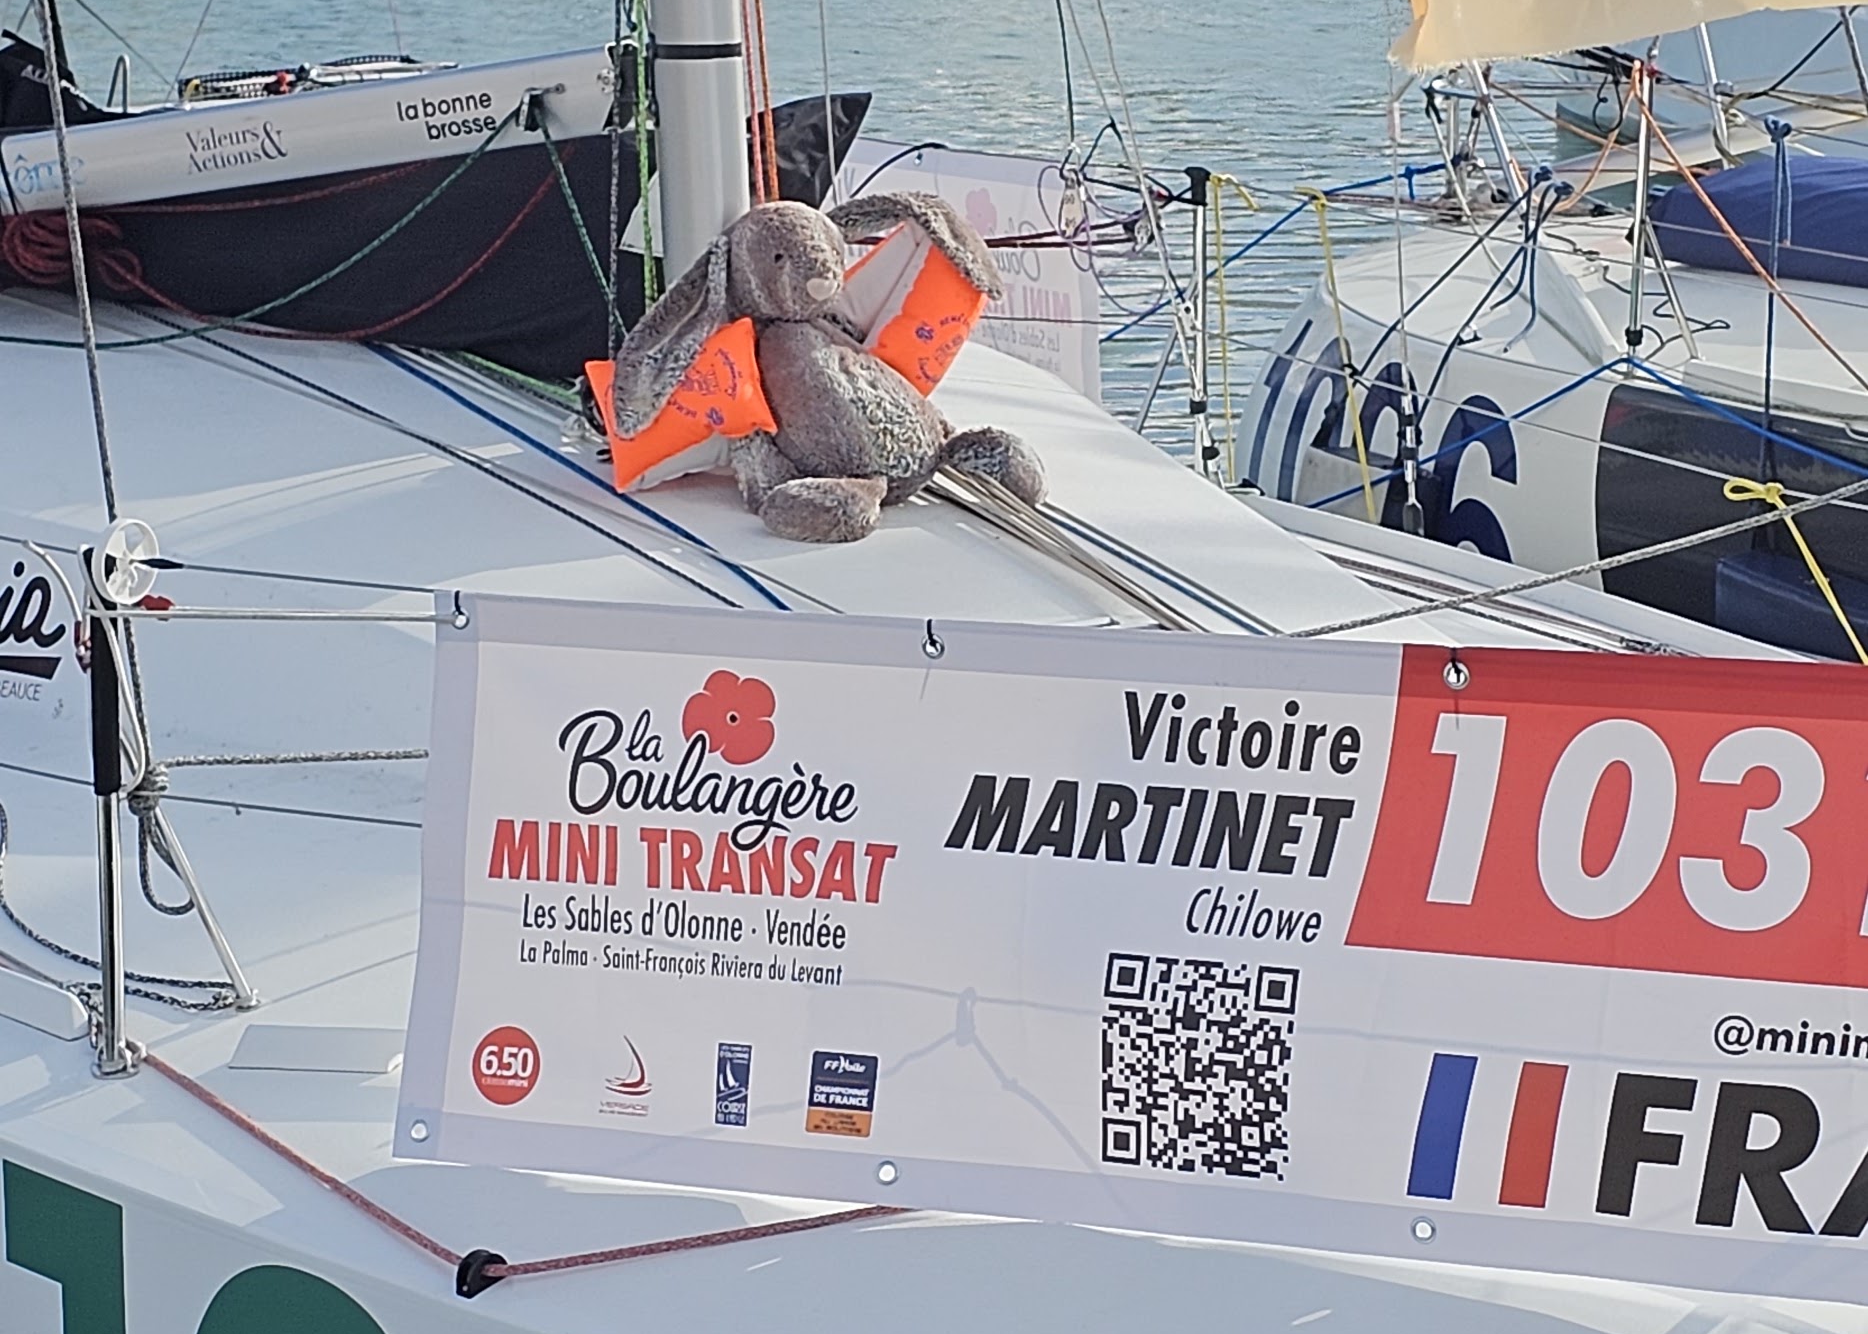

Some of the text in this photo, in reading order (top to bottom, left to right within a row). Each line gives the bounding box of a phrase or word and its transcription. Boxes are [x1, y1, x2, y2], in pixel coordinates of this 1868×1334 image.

[397, 93, 492, 121] la bonne
[425, 115, 497, 140] brosse
[186, 126, 260, 153] Valeurs
[188, 148, 262, 175] Actions
[625, 709, 663, 763] la
[1124, 690, 1361, 775] Victoire
[559, 710, 858, 851] Boulangère
[944, 774, 1355, 878] MARTINET
[1426, 712, 1868, 937] 103
[488, 819, 898, 904] MINI TRANSAT
[522, 893, 846, 949] Les Sables d'Olonne Vendée
[1186, 886, 1322, 943] Chilowe
[520, 939, 843, 986] La Palma Saint-François Riviera du Levant
[480, 1045, 534, 1078] 6.50
[829, 1094, 869, 1107] FRANCE
